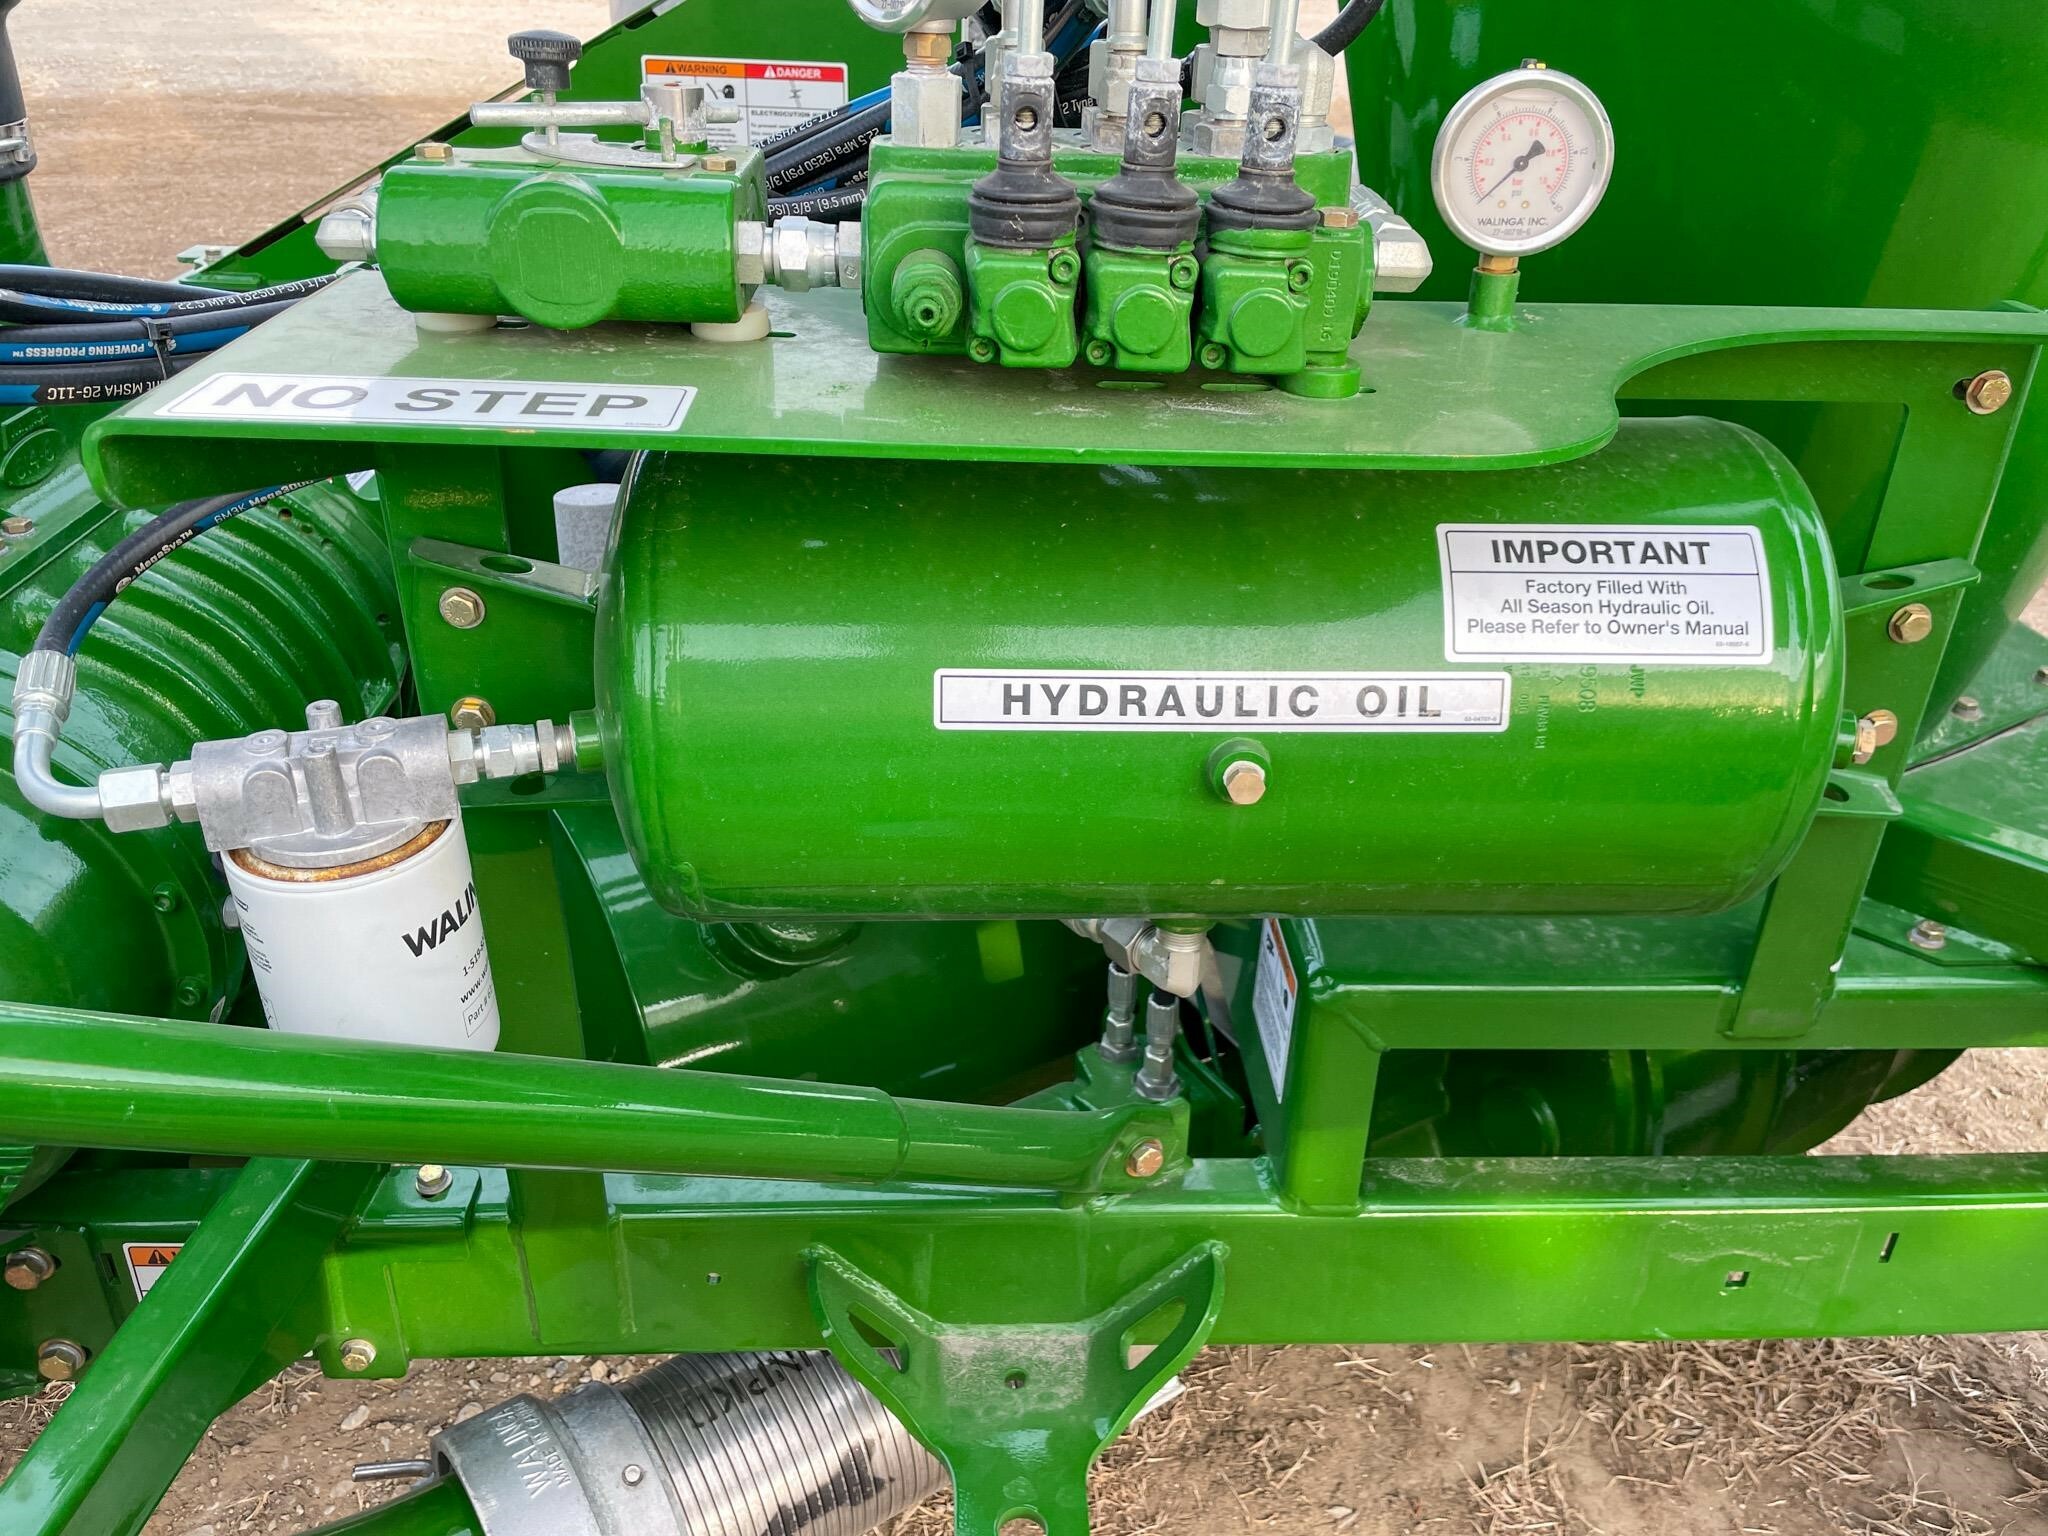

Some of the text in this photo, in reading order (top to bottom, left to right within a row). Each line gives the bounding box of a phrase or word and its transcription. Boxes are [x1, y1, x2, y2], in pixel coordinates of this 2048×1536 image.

[677, 63, 727, 75] WARNING
[776, 66, 821, 79] DANGER
[767, 126, 798, 147] MSHA
[836, 139, 859, 156] MPa
[209, 293, 236, 308] MPa
[89, 343, 145, 357] POWERING
[104, 382, 143, 397] MSHA
[212, 383, 648, 417] NO STEP
[1491, 539, 1711, 565] IMPORTANT
[1525, 580, 1687, 597] Factory Filled With
[1501, 599, 1715, 618] All Season Hydraulic Oil.
[1467, 618, 1749, 636] Please Refer to Owner's Manual
[1002, 683, 1442, 718] HYDRAULIC OIL
[467, 1003, 484, 1027] Part
[542, 1448, 572, 1489] MADE
